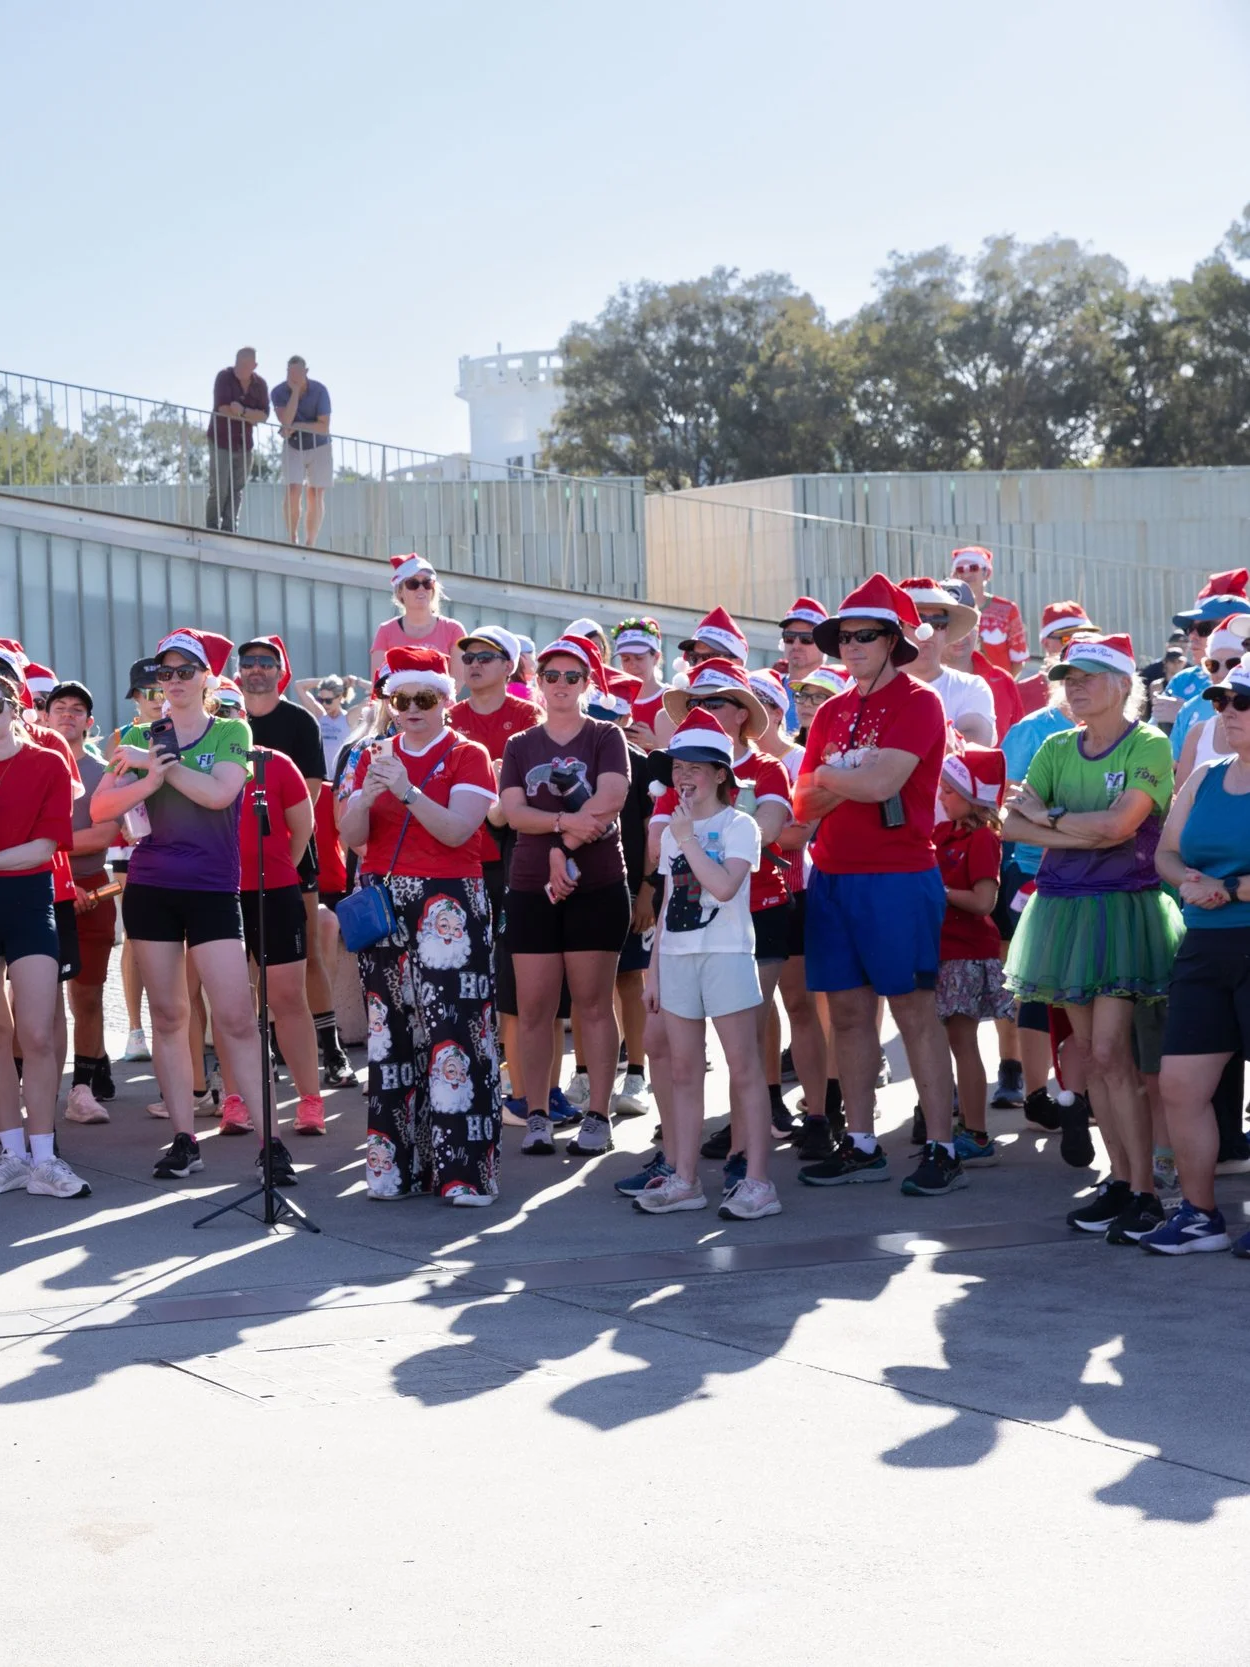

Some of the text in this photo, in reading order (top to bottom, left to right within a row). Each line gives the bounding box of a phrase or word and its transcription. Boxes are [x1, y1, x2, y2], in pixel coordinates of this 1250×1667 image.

[458, 971, 490, 1000] HO
[379, 1061, 414, 1091] HO
[466, 1114, 494, 1142] HO
